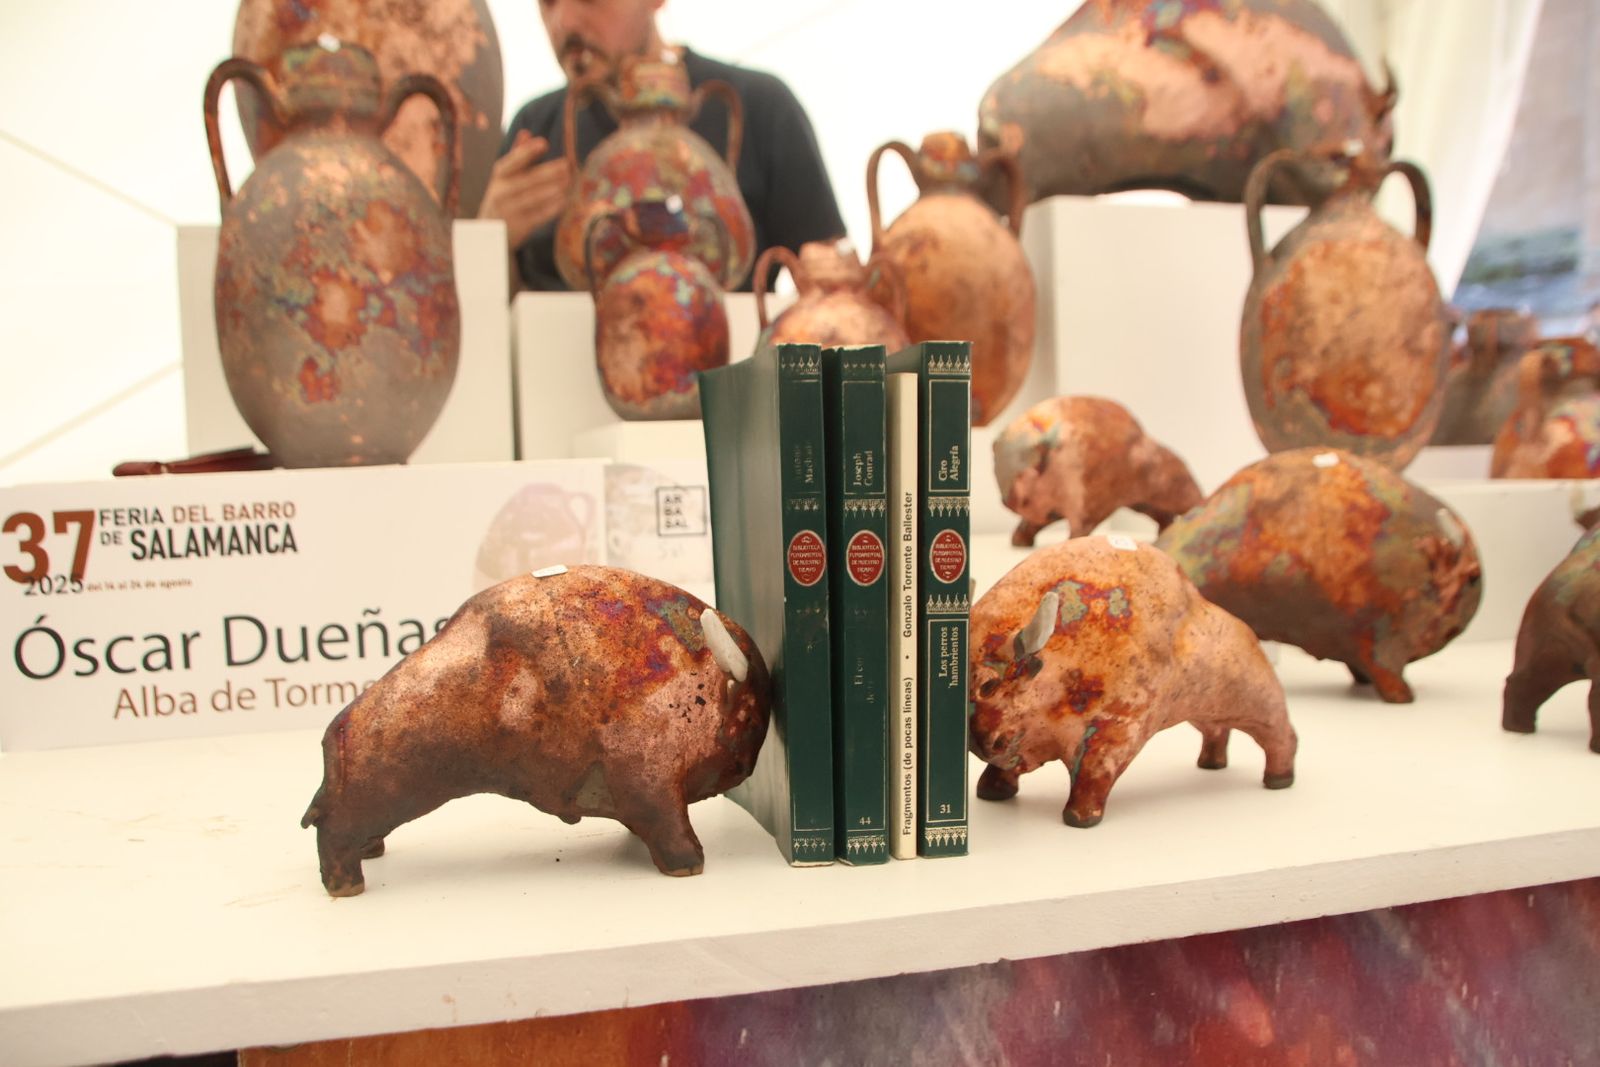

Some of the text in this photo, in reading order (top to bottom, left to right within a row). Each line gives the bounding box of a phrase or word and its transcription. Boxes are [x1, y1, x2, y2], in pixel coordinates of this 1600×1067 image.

[853, 452, 865, 487] Joseph
[864, 450, 873, 487] Conrad
[938, 459, 948, 482] Ciro
[949, 444, 960, 481] Alegría
[100, 501, 296, 527] FERIA DEL BARRO
[2, 510, 95, 585] 37
[100, 523, 298, 560] DE SALAMANCA
[23, 573, 84, 596] 2025
[14, 614, 200, 680] Óscar
[902, 491, 914, 836] Fragmentos (de pocas líneas) Gonzalo Torrente Ballester
[938, 626, 949, 677] Los perros
[949, 626, 959, 687] hambrientos
[113, 685, 198, 720] Alba
[210, 680, 257, 713] de
[859, 816, 871, 825] 44
[939, 804, 951, 814] 31
